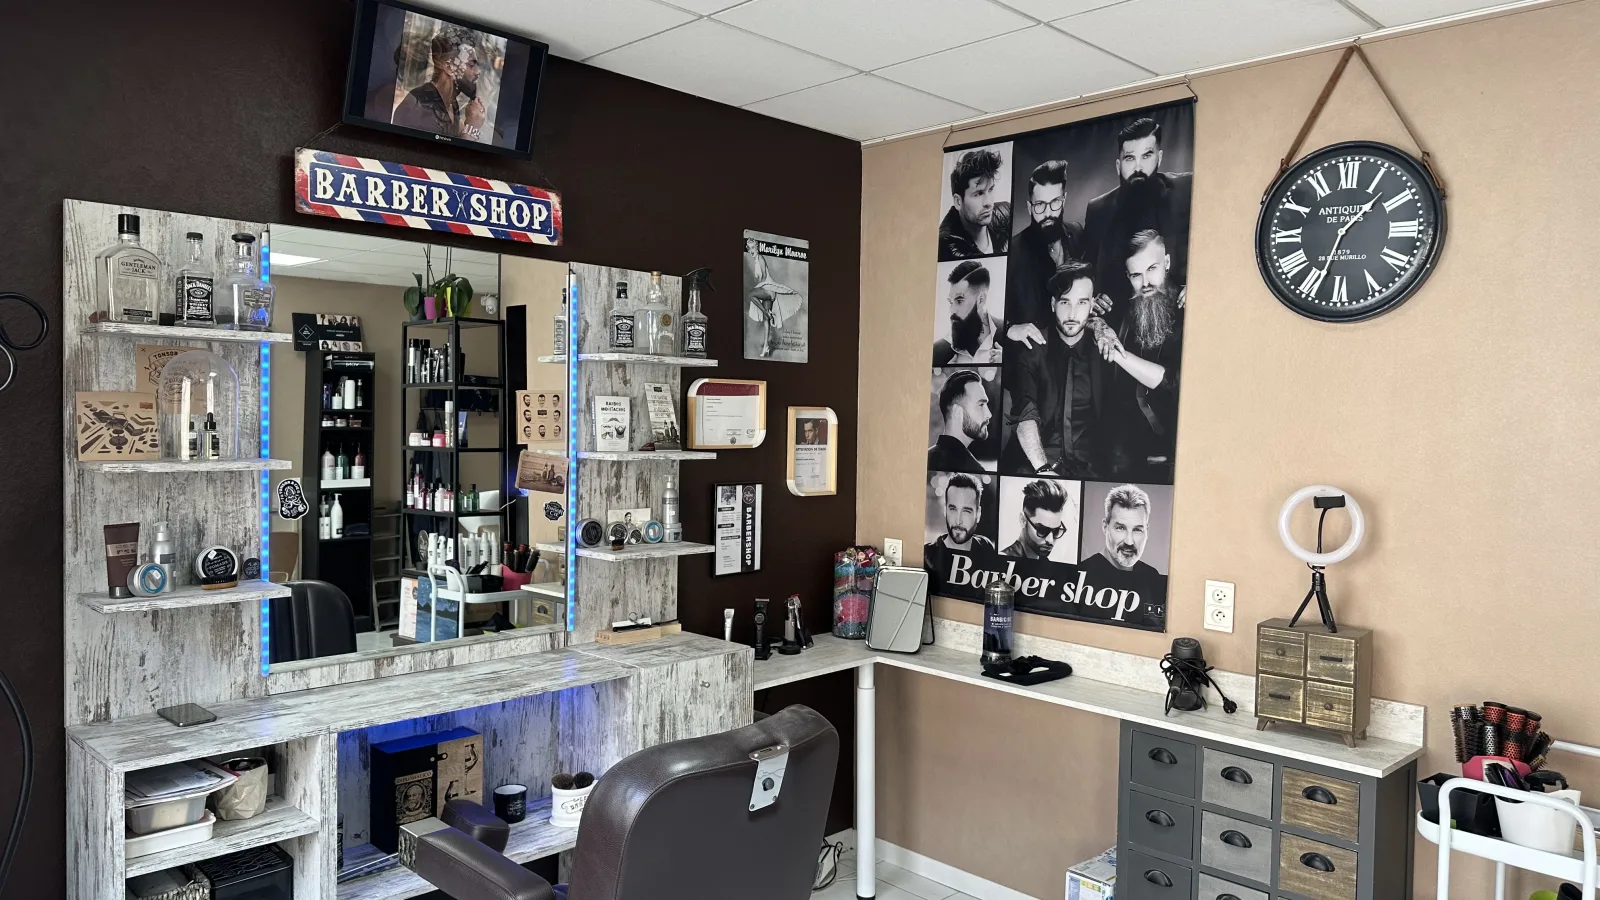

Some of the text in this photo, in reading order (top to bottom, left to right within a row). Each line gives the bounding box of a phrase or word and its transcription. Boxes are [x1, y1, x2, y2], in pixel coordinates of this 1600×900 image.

[1306, 170, 1332, 201] XI
[1337, 161, 1361, 190] XII
[1366, 167, 1387, 194] I
[314, 168, 549, 231] BARBER SHOP
[1283, 196, 1311, 218] X
[1382, 188, 1413, 213] II
[1326, 215, 1364, 224] DE PARS
[1388, 218, 1419, 239] III
[1275, 227, 1302, 244] IX
[121, 261, 156, 270] GENTLEMAN
[1278, 248, 1309, 280] VIII
[1330, 275, 1348, 302] VI
[1364, 269, 1382, 296] V
[947, 554, 1141, 621] Barber shop
